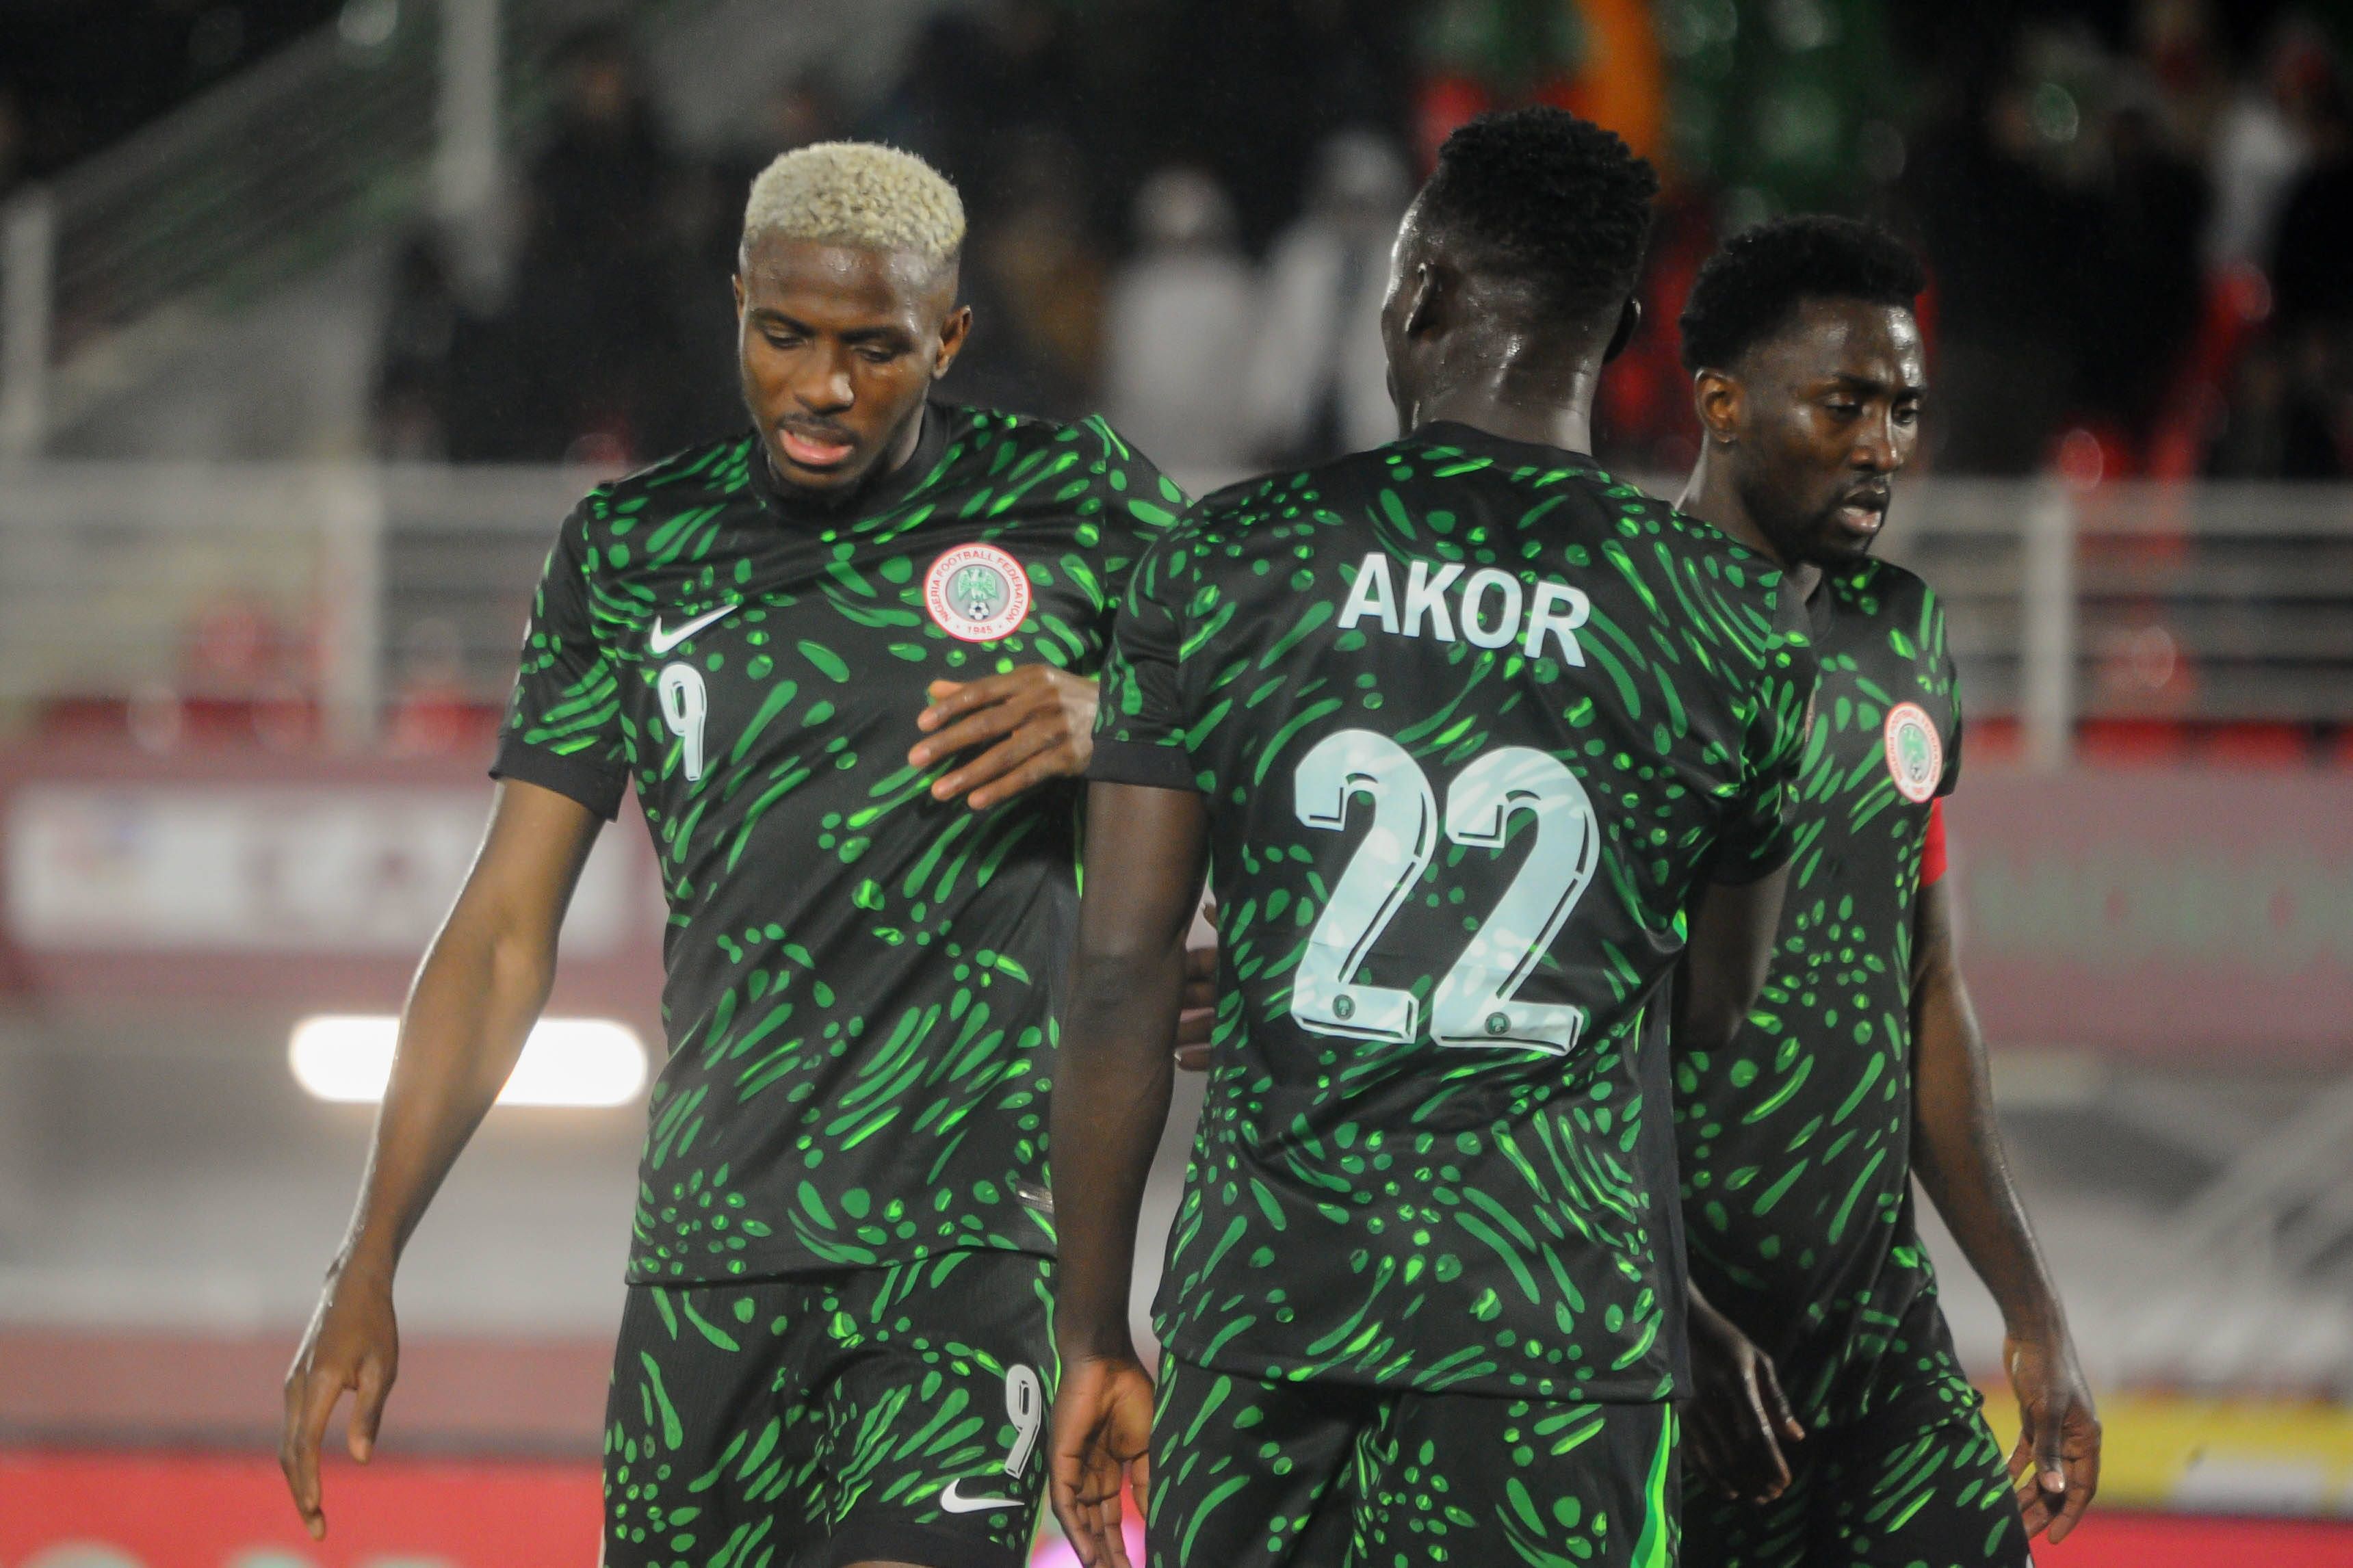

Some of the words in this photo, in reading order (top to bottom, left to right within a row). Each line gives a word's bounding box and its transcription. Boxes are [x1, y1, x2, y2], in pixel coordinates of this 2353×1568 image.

[931, 579, 950, 621] NIGERIA
[936, 550, 994, 576] FOOTBALL
[997, 558, 1024, 623] FEDERATION
[968, 625, 993, 634] 1945
[1337, 552, 1591, 667] AKOR
[659, 662, 707, 781] 9
[1291, 729, 1600, 1056] 22
[1006, 1364, 1041, 1478] 9
